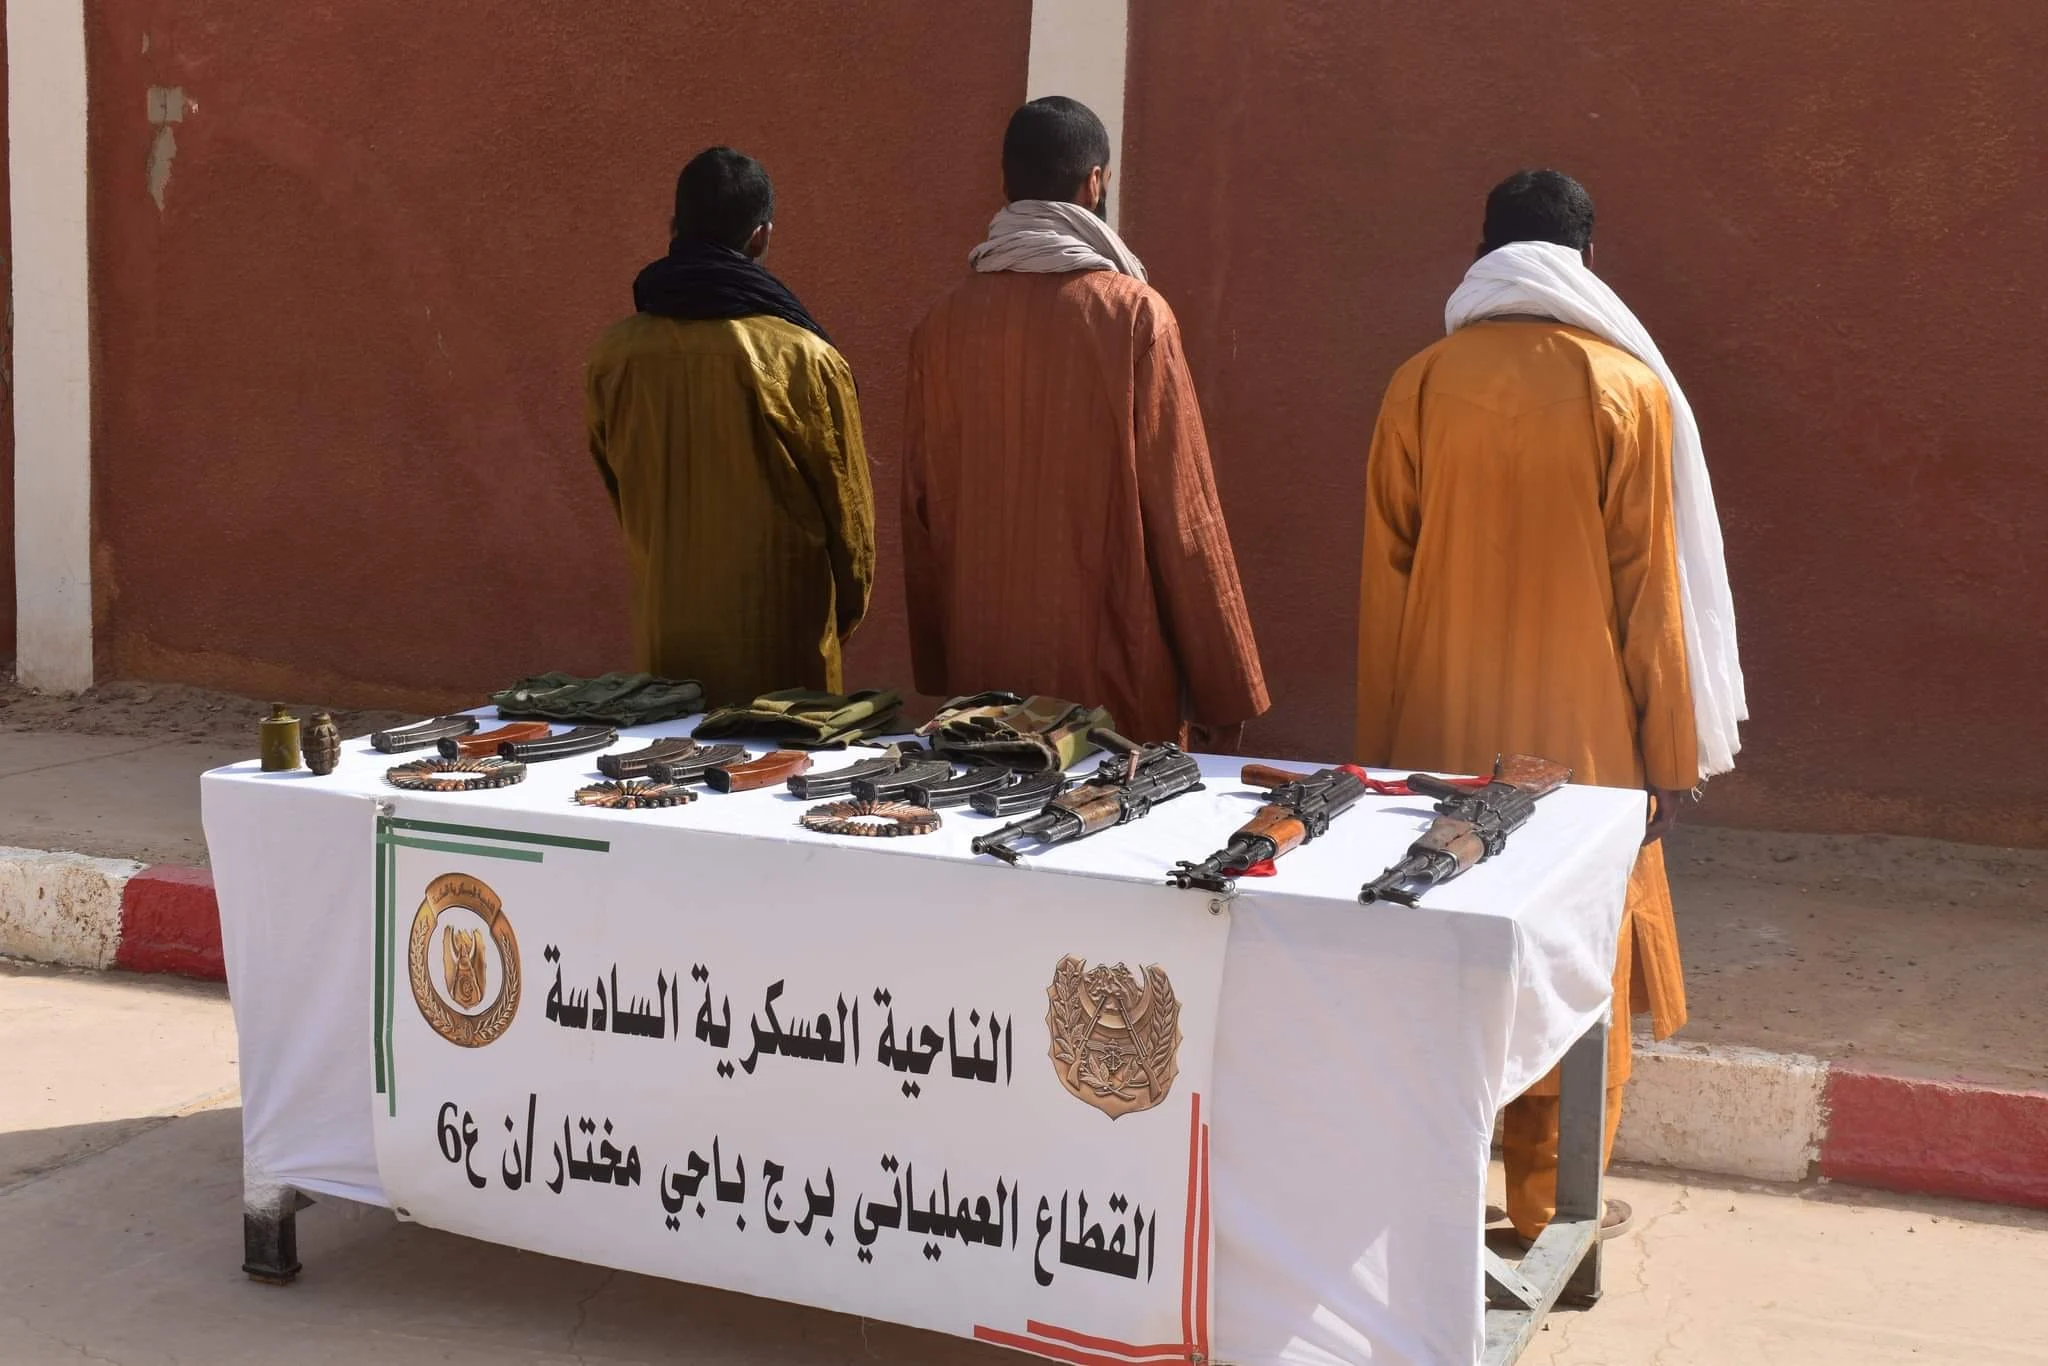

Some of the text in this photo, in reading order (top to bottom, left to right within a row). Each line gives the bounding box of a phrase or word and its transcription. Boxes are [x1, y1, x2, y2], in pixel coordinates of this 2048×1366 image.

[543, 944, 1012, 1099] الناحية العسكرية السادسة
[660, 1135, 747, 1233] باجي
[762, 1159, 835, 1247] برج
[853, 1153, 1018, 1265] العملياتي
[1034, 1189, 1156, 1287] القطاع
